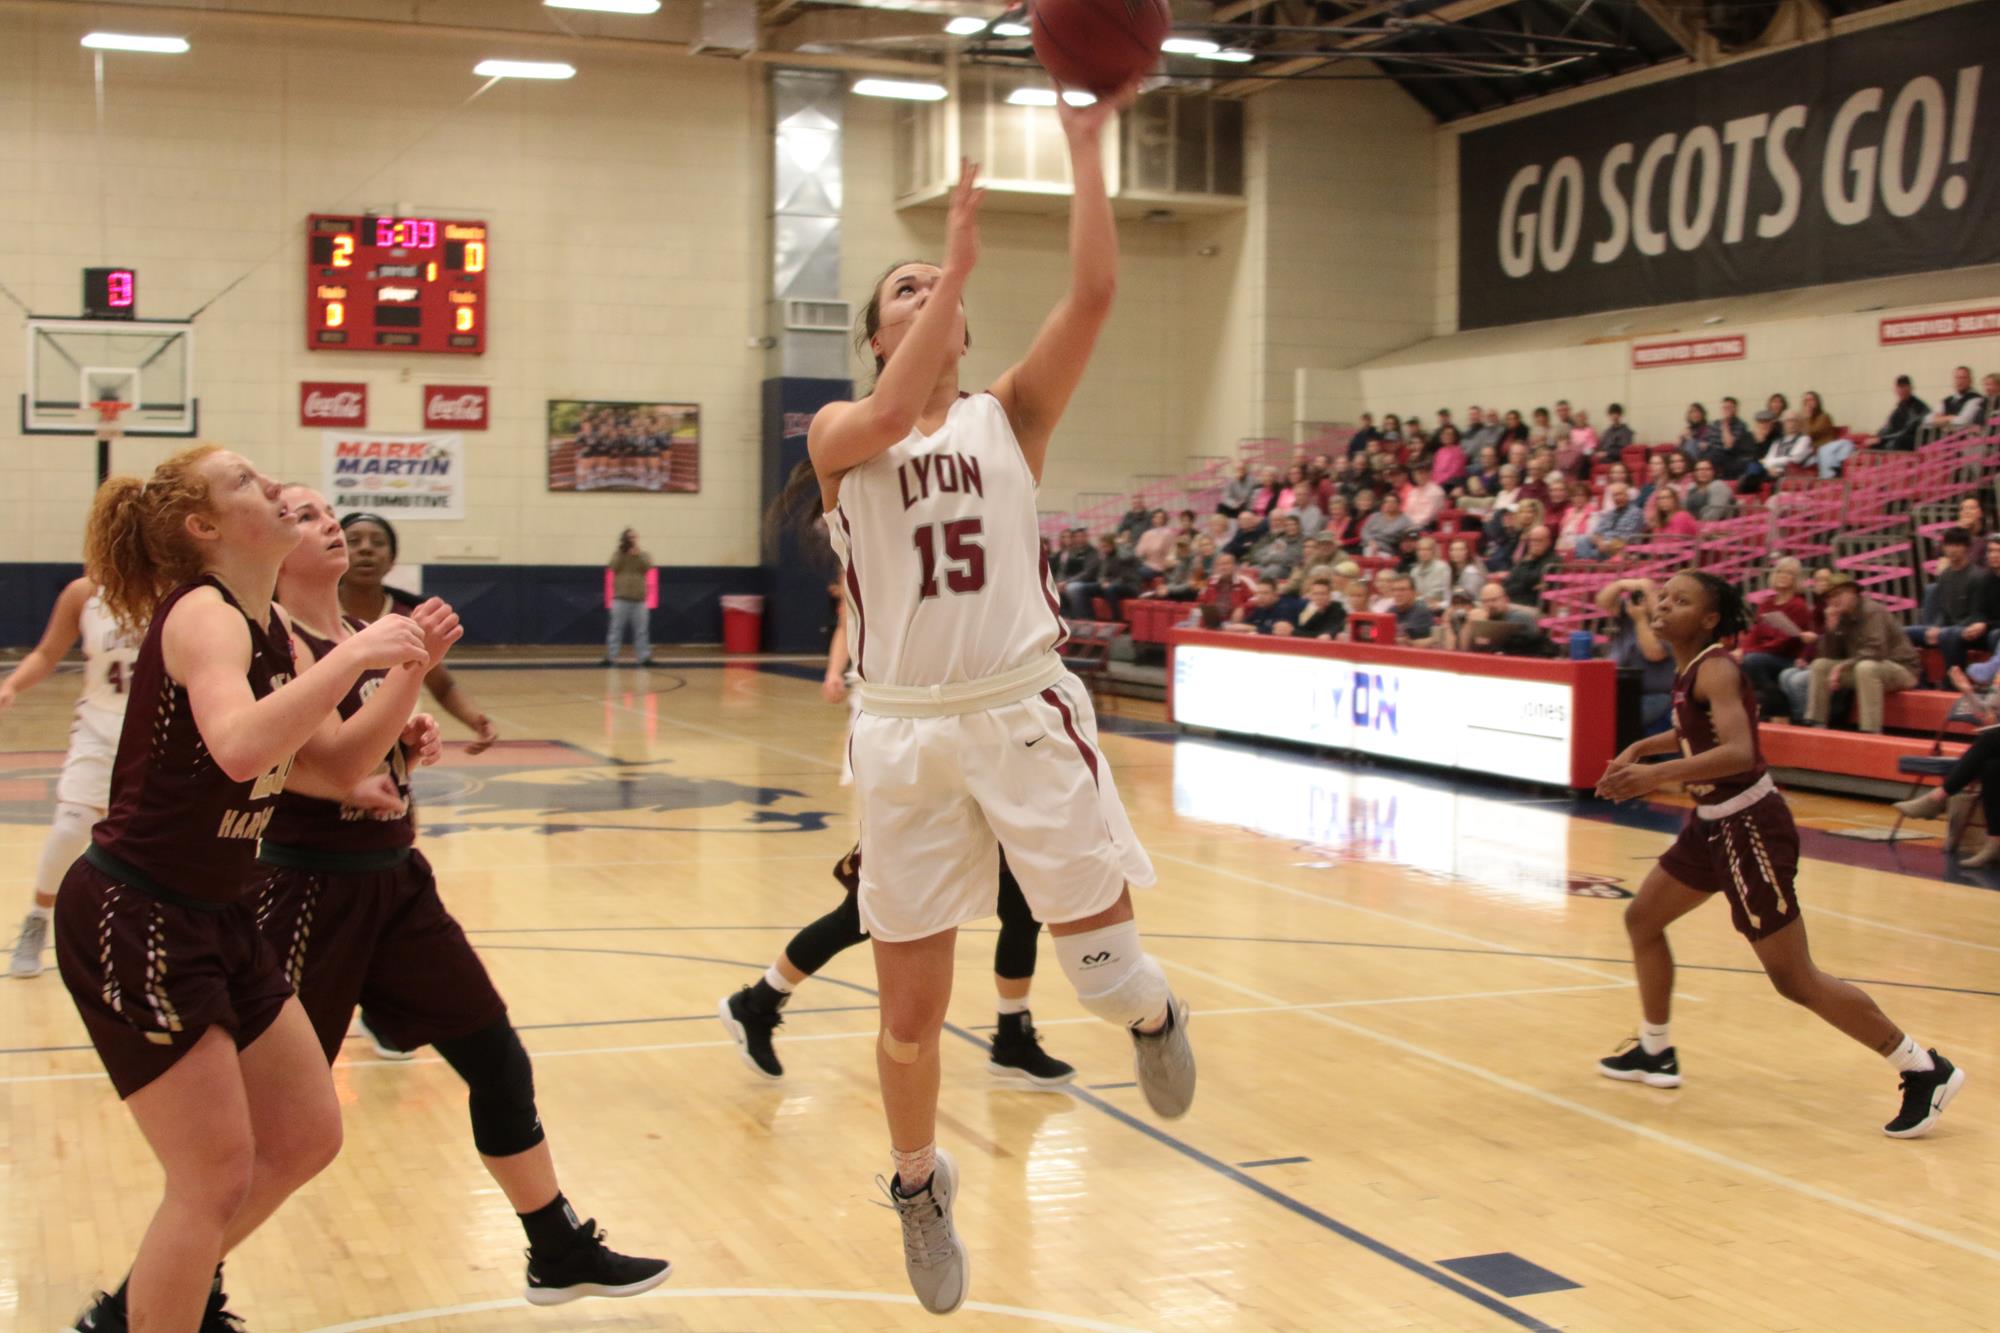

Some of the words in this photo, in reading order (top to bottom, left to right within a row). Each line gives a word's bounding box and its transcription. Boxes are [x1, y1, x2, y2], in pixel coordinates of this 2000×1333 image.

[1498, 155, 1584, 278] GO
[1592, 105, 1808, 264] SCOTS
[1823, 65, 1983, 226] GO!
[333, 235, 354, 267] 2
[464, 242, 485, 272] 0
[336, 441, 428, 458] MARK
[336, 459, 451, 475] MARTIN
[898, 452, 984, 511] LYON
[336, 494, 450, 508] AUTOMOTIVE
[913, 516, 987, 600] 15
